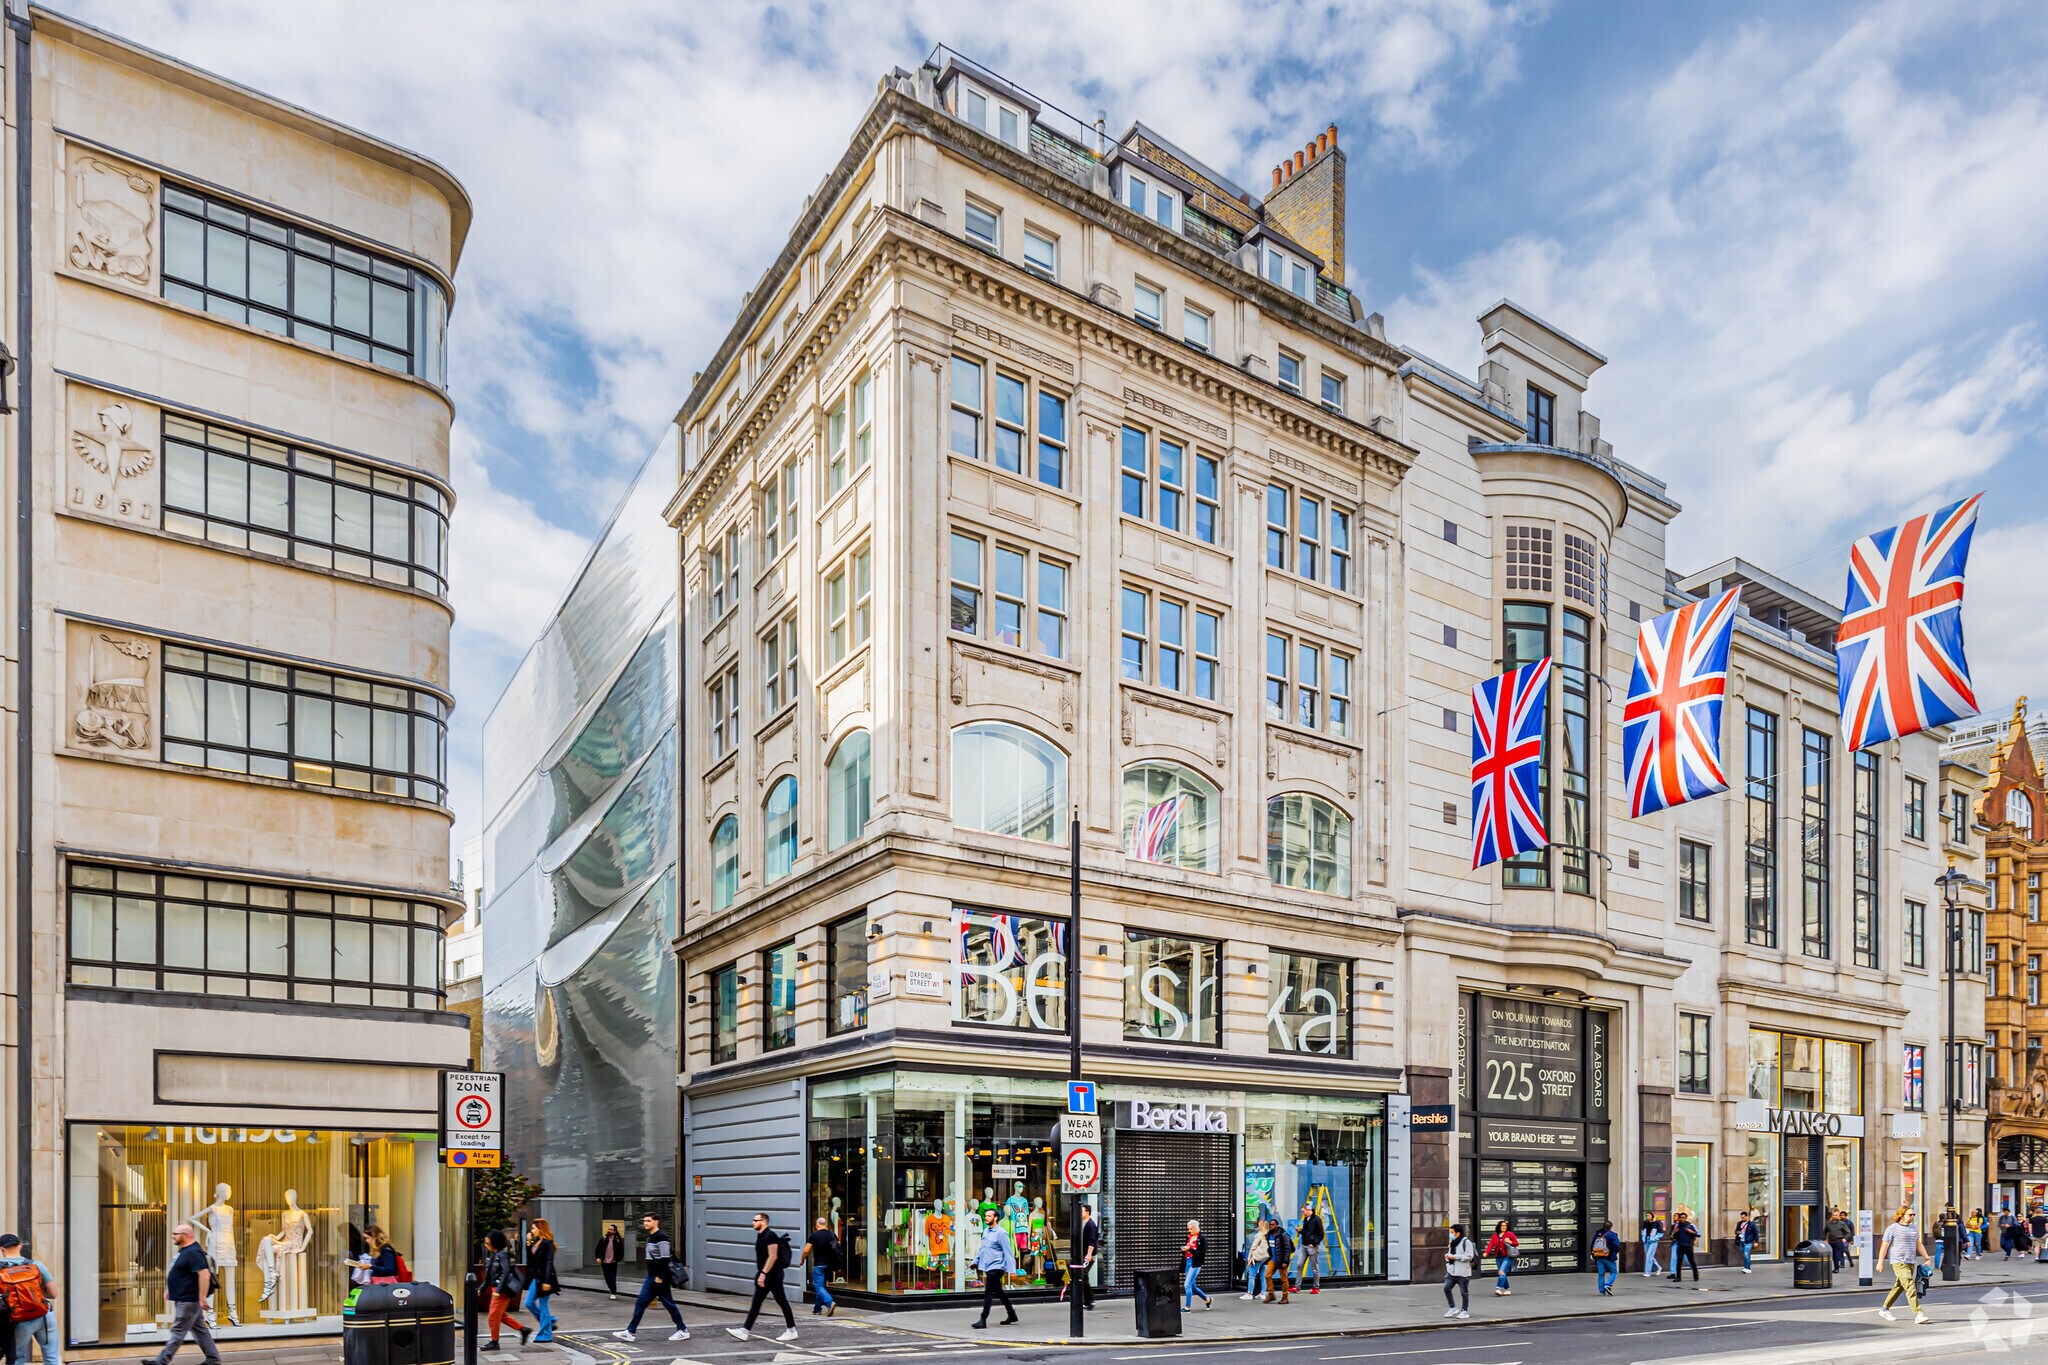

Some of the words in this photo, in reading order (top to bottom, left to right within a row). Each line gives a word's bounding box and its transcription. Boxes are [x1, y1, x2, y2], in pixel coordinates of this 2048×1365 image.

[909, 970, 932, 979] OXFORD
[909, 979, 930, 987] STREET
[1491, 1010, 1504, 1020] ON
[1505, 1011, 1524, 1023] YOUR
[1525, 1014, 1539, 1025] WAY
[1541, 1016, 1572, 1028] TOWARDS
[1594, 1024, 1602, 1048] ALL
[1494, 1035, 1508, 1046] THE
[1508, 1037, 1528, 1047] NEXT
[1528, 1038, 1570, 1051] DESTINATION
[450, 1074, 498, 1082] PEDESTRIAN
[1486, 1059, 1534, 1102] 225
[1538, 1069, 1576, 1083] OXFORD
[1594, 1052, 1602, 1108] ABOARD
[457, 1082, 490, 1092] ZONE
[1542, 1083, 1573, 1097] STREET
[1131, 1100, 1228, 1132] Bershka
[1412, 1113, 1448, 1125] Bershka
[1768, 1108, 1842, 1136] MANGO
[1067, 1119, 1094, 1128] WEAK
[455, 1133, 479, 1141] Except
[1068, 1130, 1094, 1139] ROAD
[1488, 1131, 1510, 1142] YOUR
[1511, 1132, 1537, 1143] BRAND
[1537, 1134, 1556, 1144] HERE
[1070, 1159, 1093, 1171] 25T
[1548, 1241, 1561, 1249] NOW
[1516, 1257, 1530, 1269] 225
